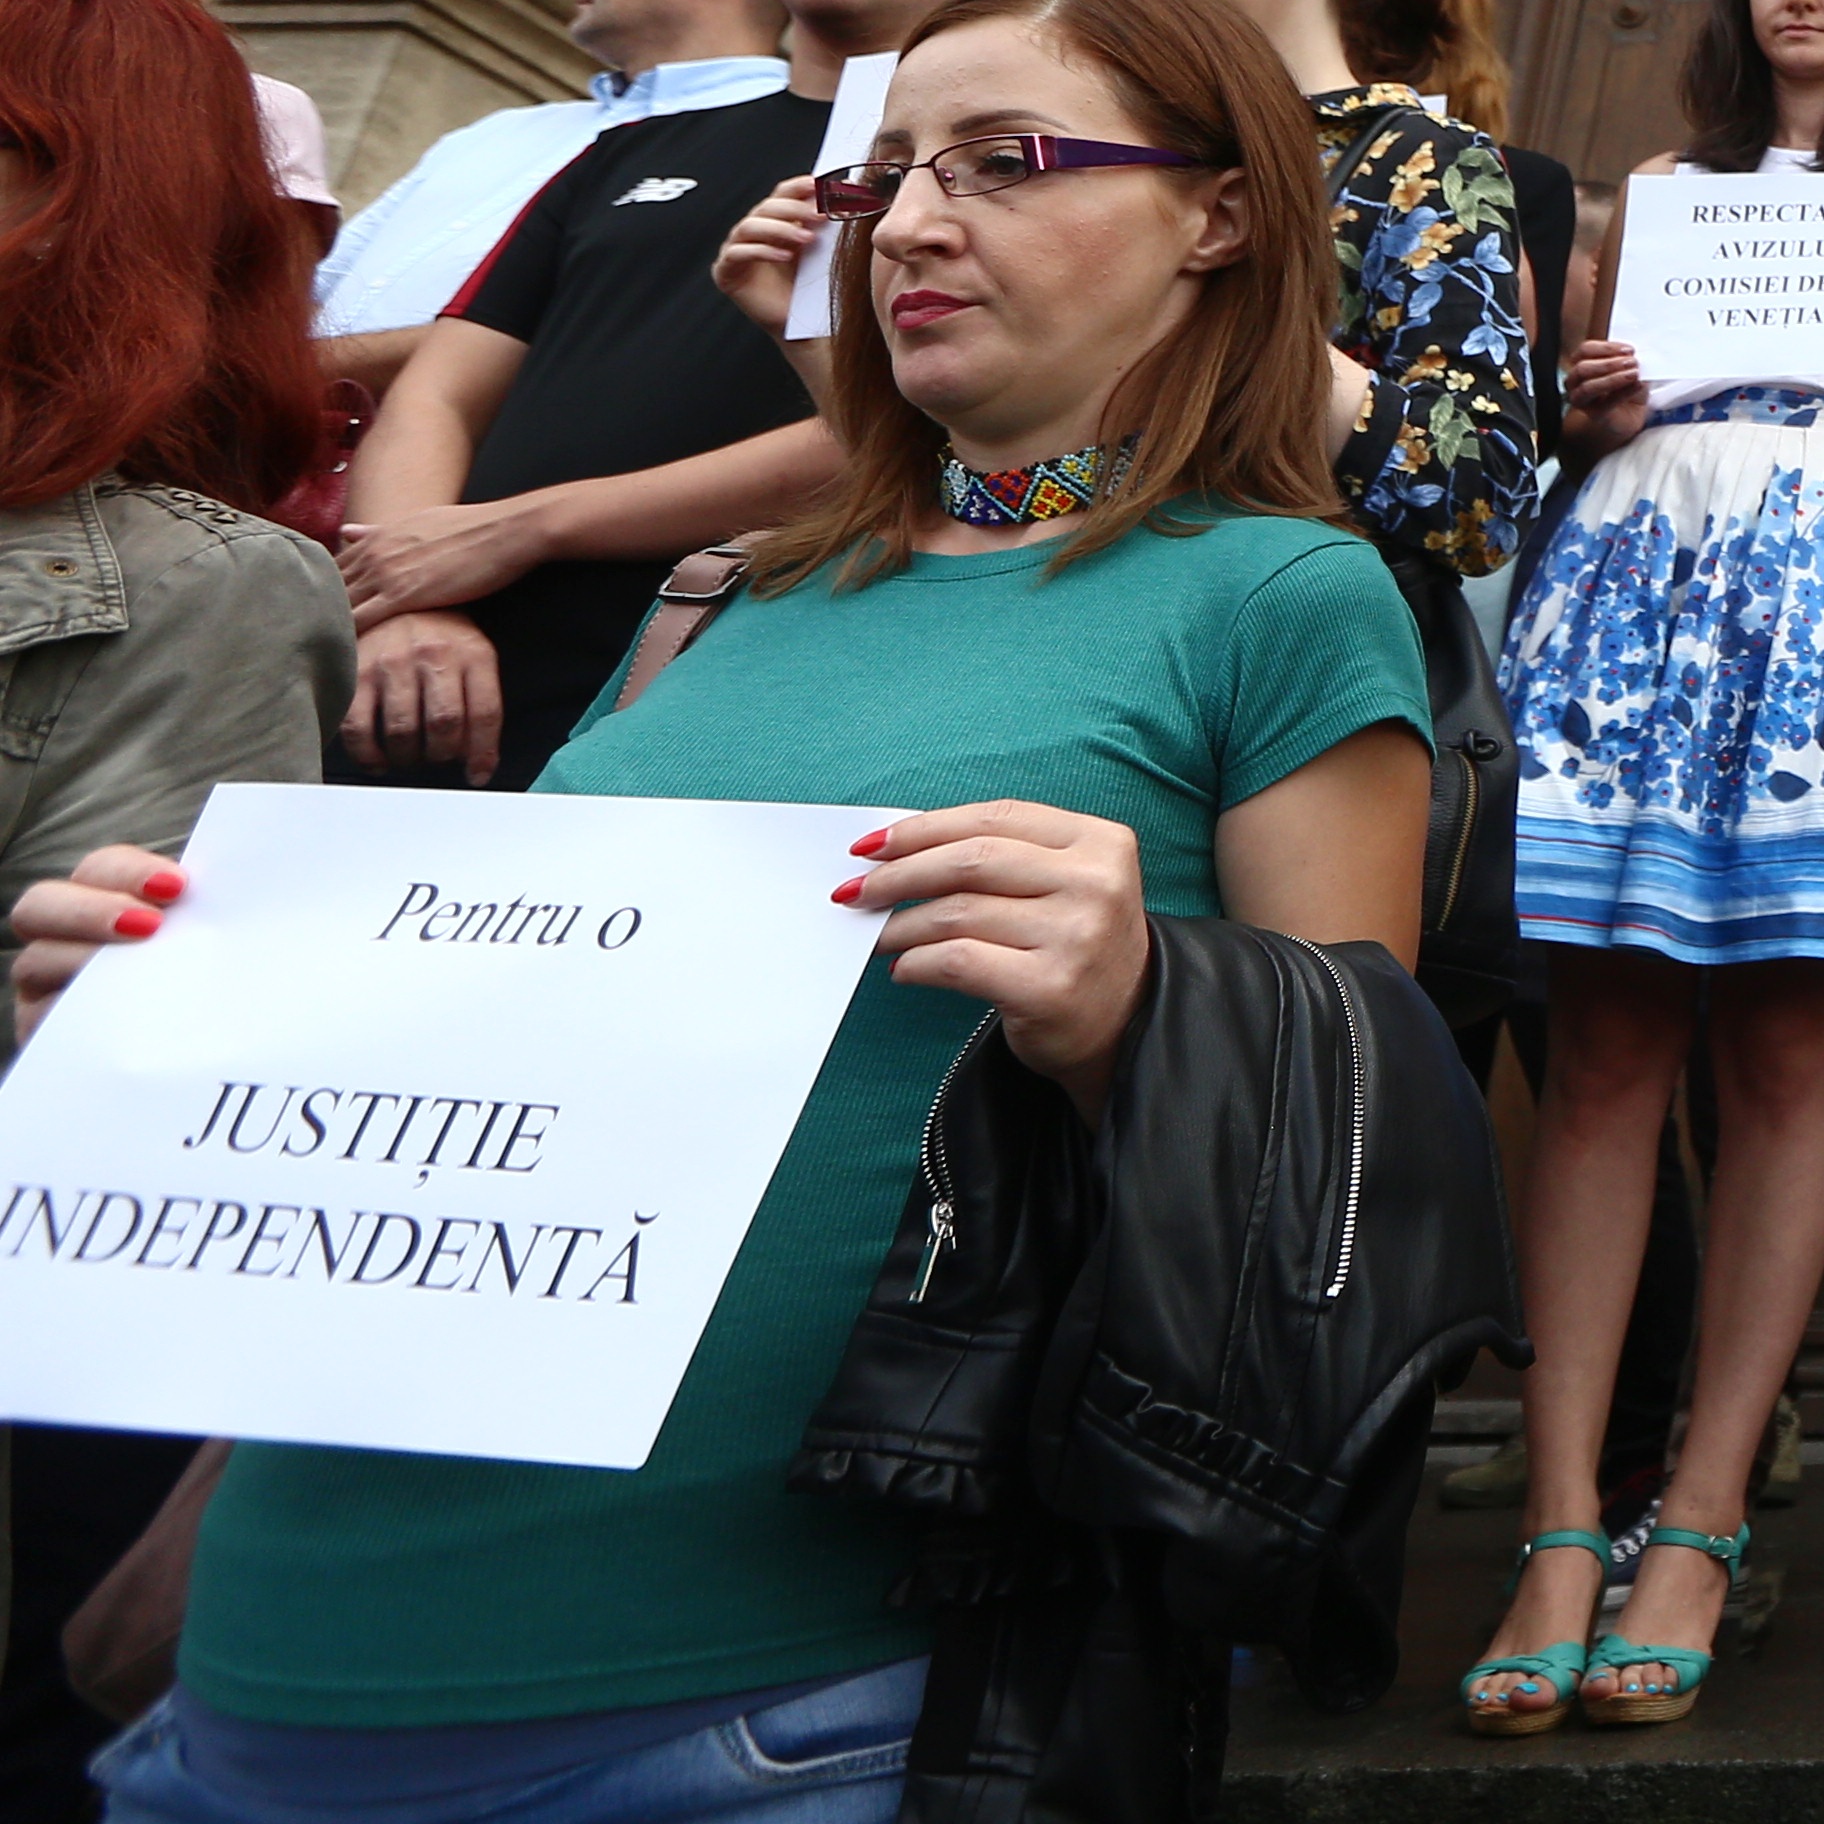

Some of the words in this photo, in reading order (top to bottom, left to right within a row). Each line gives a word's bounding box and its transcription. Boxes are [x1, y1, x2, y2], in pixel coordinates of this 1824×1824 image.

[1664, 275, 1789, 297] COMISIEI
[1707, 307, 1822, 329] VENEȚIA
[372, 882, 584, 946] Pentru
[597, 907, 642, 950] o
[182, 1082, 560, 1188] JUSTIȚIE
